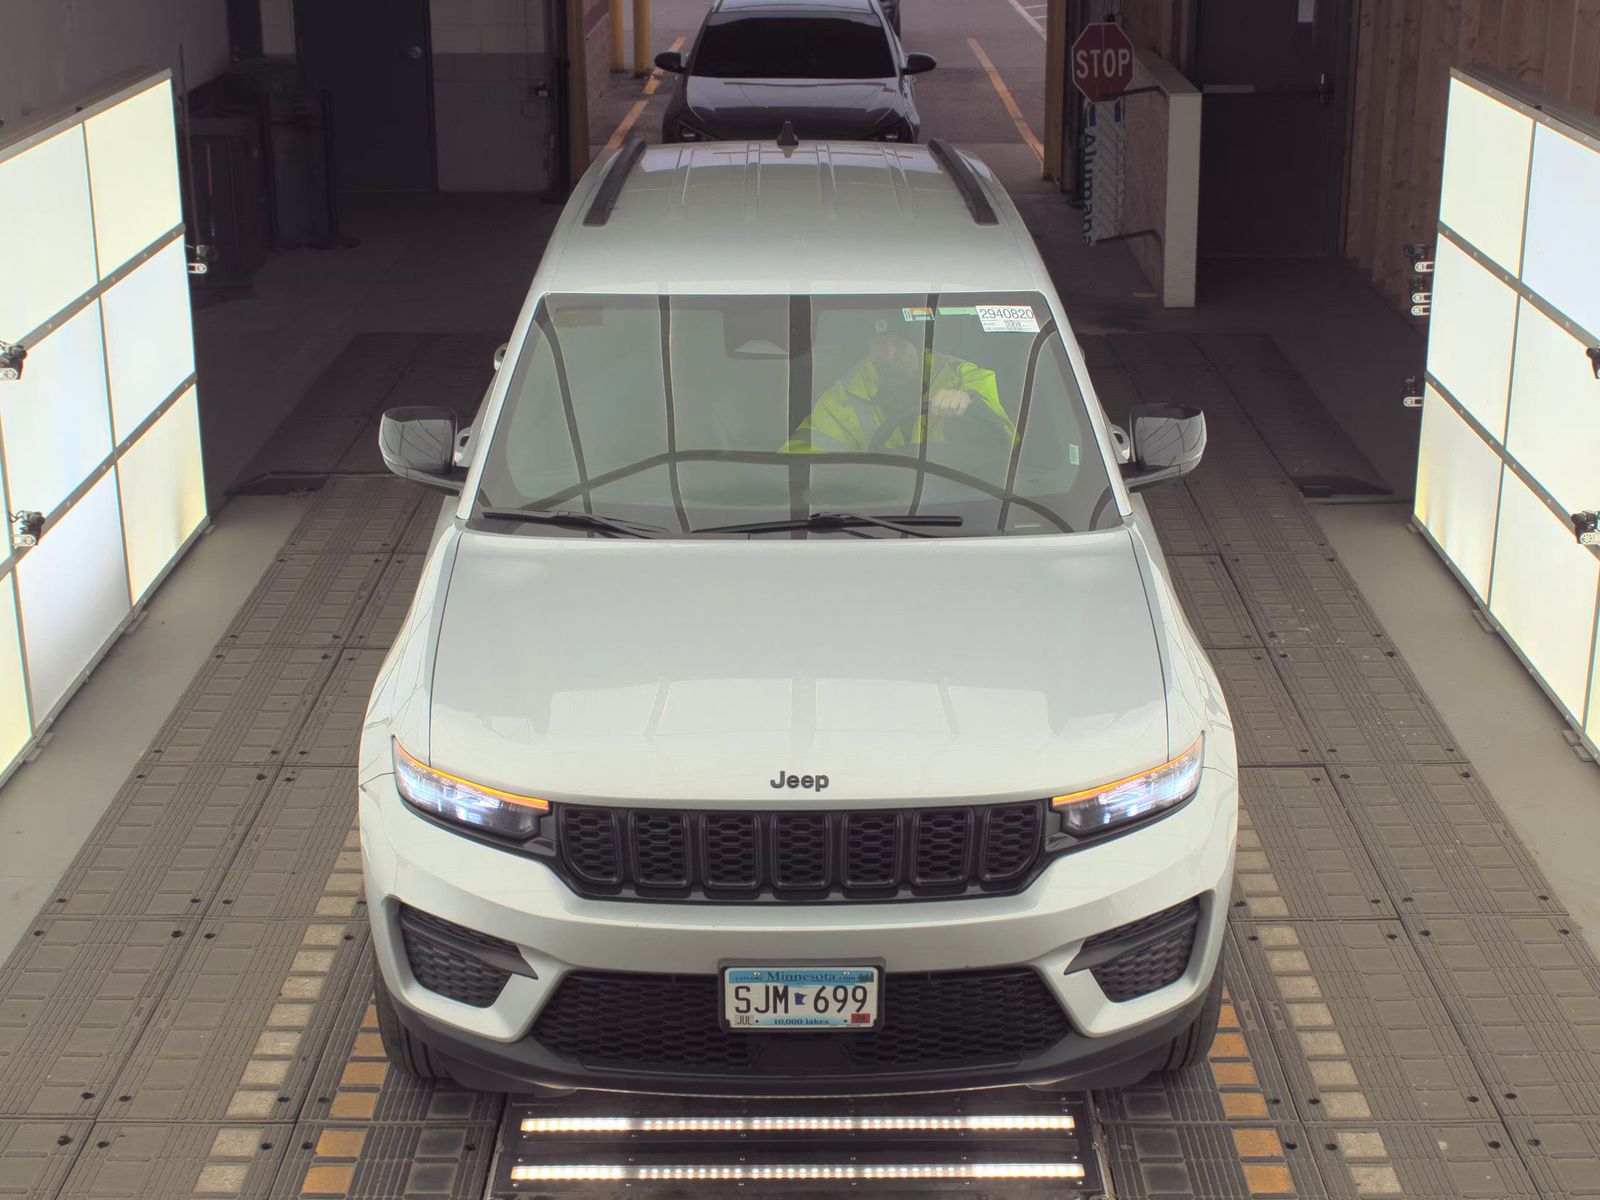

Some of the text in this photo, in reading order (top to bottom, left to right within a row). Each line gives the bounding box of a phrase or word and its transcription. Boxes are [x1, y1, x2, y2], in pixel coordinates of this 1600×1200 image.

[1076, 48, 1131, 79] STOP
[979, 308, 1034, 320] 2940820
[769, 770, 830, 792] Jeep
[734, 985, 868, 1014] SJM 699
[736, 1015, 753, 1026] JUL
[774, 1018, 803, 1026] 10,000
